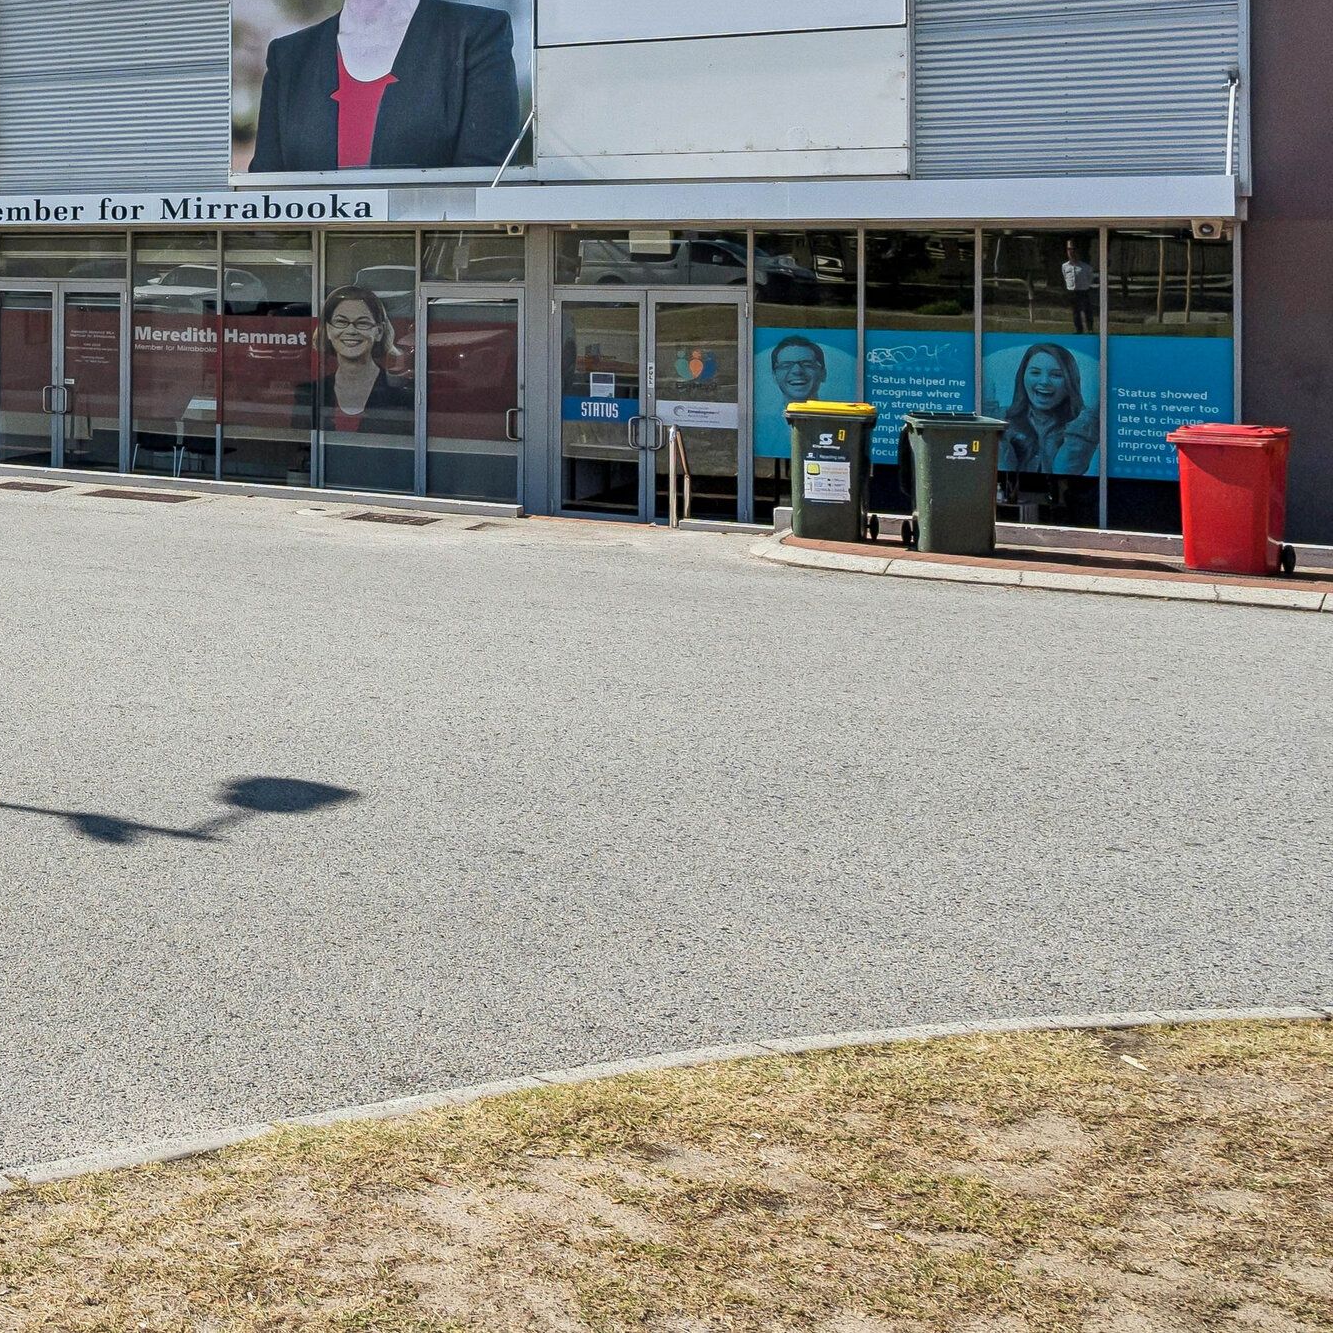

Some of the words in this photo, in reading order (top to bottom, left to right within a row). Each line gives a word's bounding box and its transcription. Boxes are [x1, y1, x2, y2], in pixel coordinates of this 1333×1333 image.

[98, 197, 145, 222] for
[159, 194, 373, 221] Mirrabooka
[134, 326, 218, 343] Meredith
[224, 328, 307, 346] Hammat
[134, 343, 164, 352] Member
[165, 344, 175, 352] for
[176, 344, 218, 353] Mirrabooka
[909, 376, 946, 388] helped
[948, 378, 967, 387] me
[871, 388, 923, 399] recognise
[926, 389, 961, 399] where
[1160, 389, 1208, 401] showed
[581, 401, 619, 418] STATUS
[871, 400, 891, 410] my
[891, 400, 943, 411] strengths
[945, 402, 964, 411] are
[1117, 402, 1137, 411] me
[1140, 401, 1158, 411] it's
[1161, 404, 1195, 413] never
[1199, 404, 1220, 414] too
[1117, 414, 1141, 424] late
[1144, 415, 1156, 425] to
[1117, 440, 1166, 451] improve
[1117, 453, 1162, 464] current
